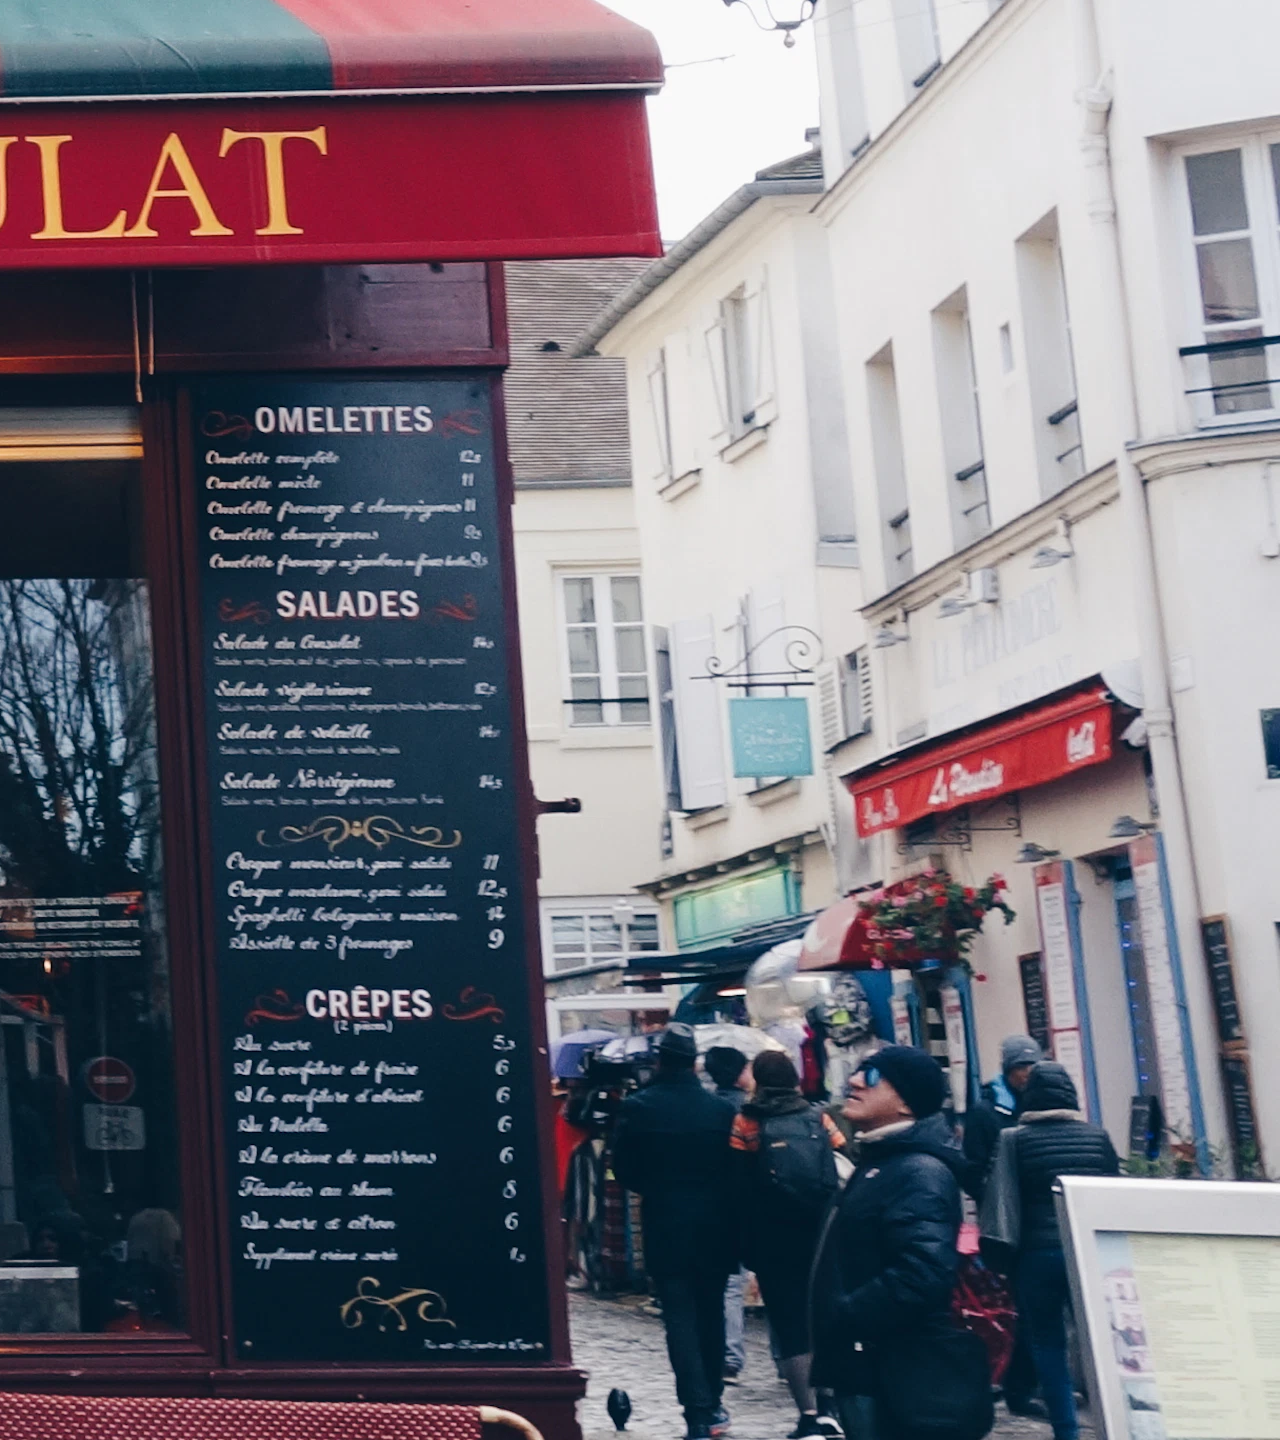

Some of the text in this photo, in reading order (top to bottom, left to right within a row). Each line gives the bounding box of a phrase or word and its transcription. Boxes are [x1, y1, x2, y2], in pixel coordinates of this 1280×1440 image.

[254, 405, 435, 435] OMELETTES
[275, 589, 421, 619] SALADES
[486, 927, 505, 951] 9
[305, 984, 434, 1020] CRÊPES
[494, 1058, 511, 1077] 6
[495, 1086, 512, 1105] 6
[496, 1114, 513, 1134] 6
[499, 1145, 516, 1164] 6
[504, 1211, 520, 1231] 6
